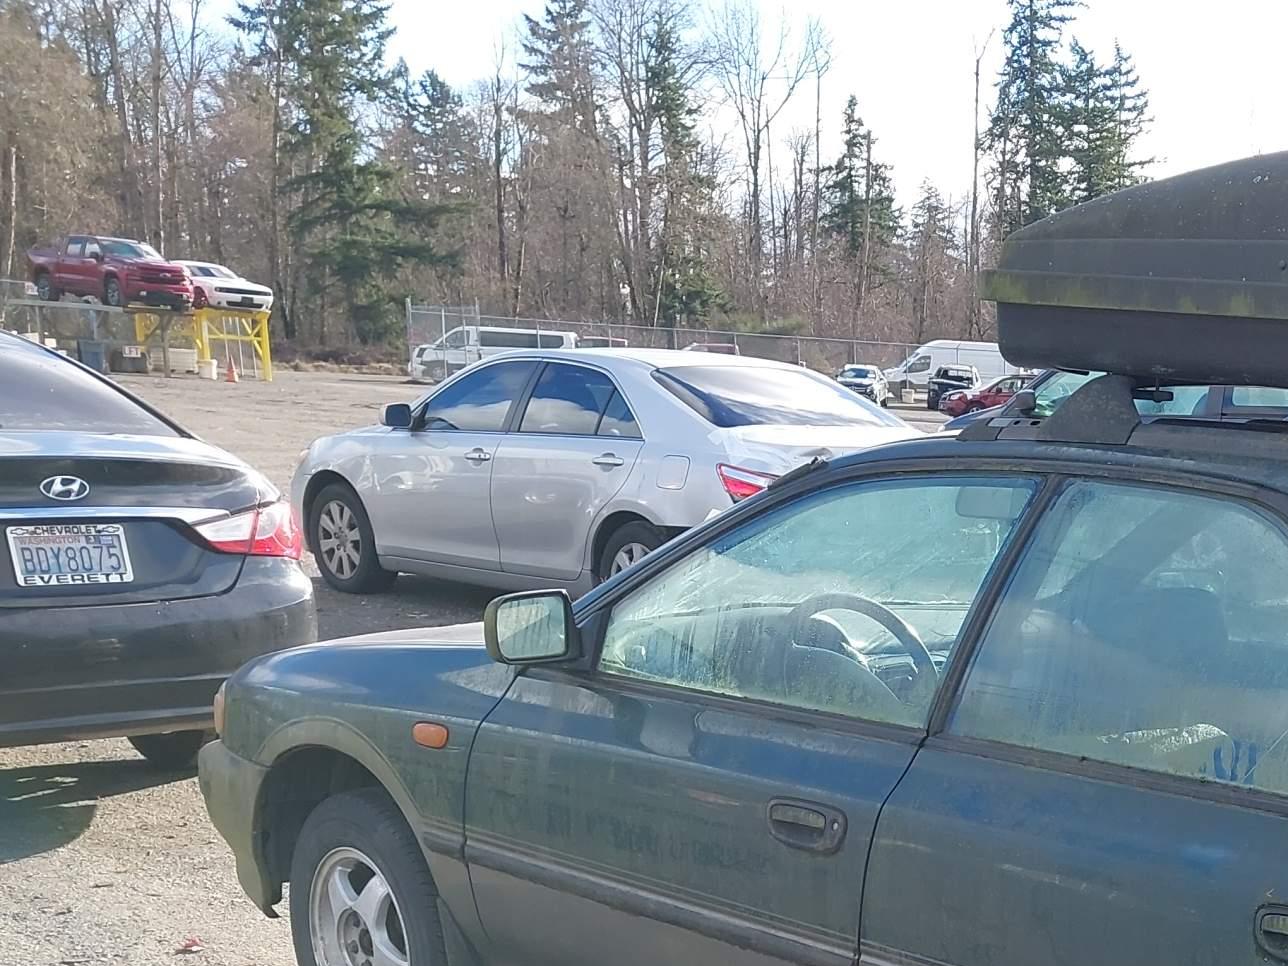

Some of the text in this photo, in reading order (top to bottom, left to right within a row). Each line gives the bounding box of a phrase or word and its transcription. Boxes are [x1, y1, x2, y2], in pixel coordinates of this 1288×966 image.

[33, 525, 98, 536] CHEVROLET
[19, 536, 81, 545] WASHINGTON
[20, 546, 122, 574] BDY8075
[24, 574, 126, 585] EVERETT
